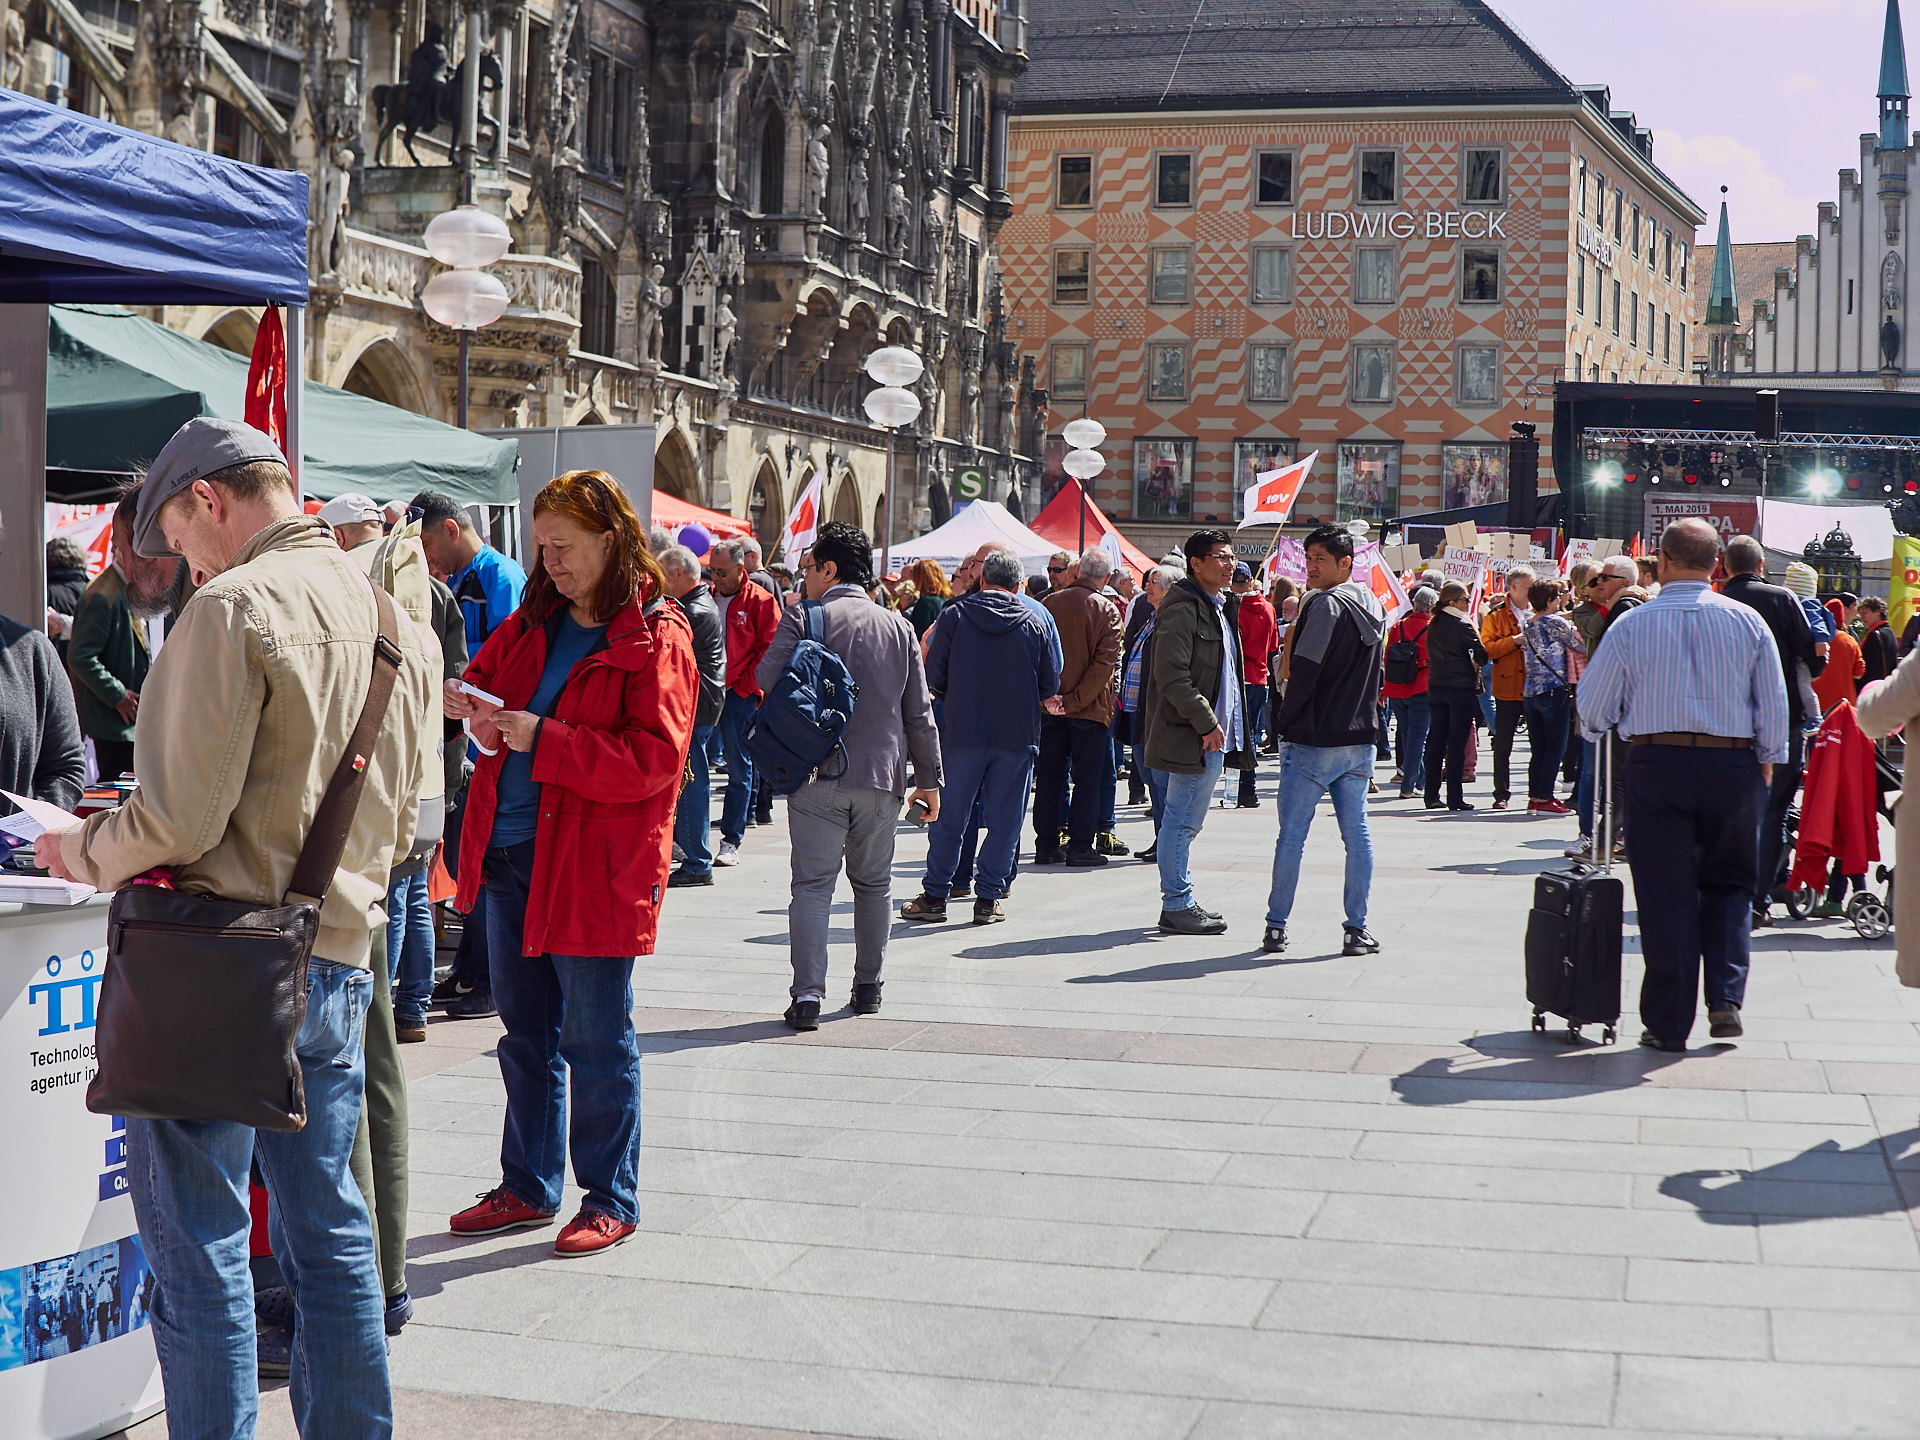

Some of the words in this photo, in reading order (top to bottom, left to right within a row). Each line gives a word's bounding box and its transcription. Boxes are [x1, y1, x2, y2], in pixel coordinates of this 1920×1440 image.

[1291, 211, 1416, 239] LUDWIG
[1426, 211, 1508, 239] BECK
[961, 470, 982, 497] S
[1655, 505, 1663, 513] 1.
[1665, 505, 1684, 513] MAI
[1686, 504, 1707, 513] 2019
[1232, 544, 1269, 554] UDWIG
[30, 1070, 82, 1094] agentur
